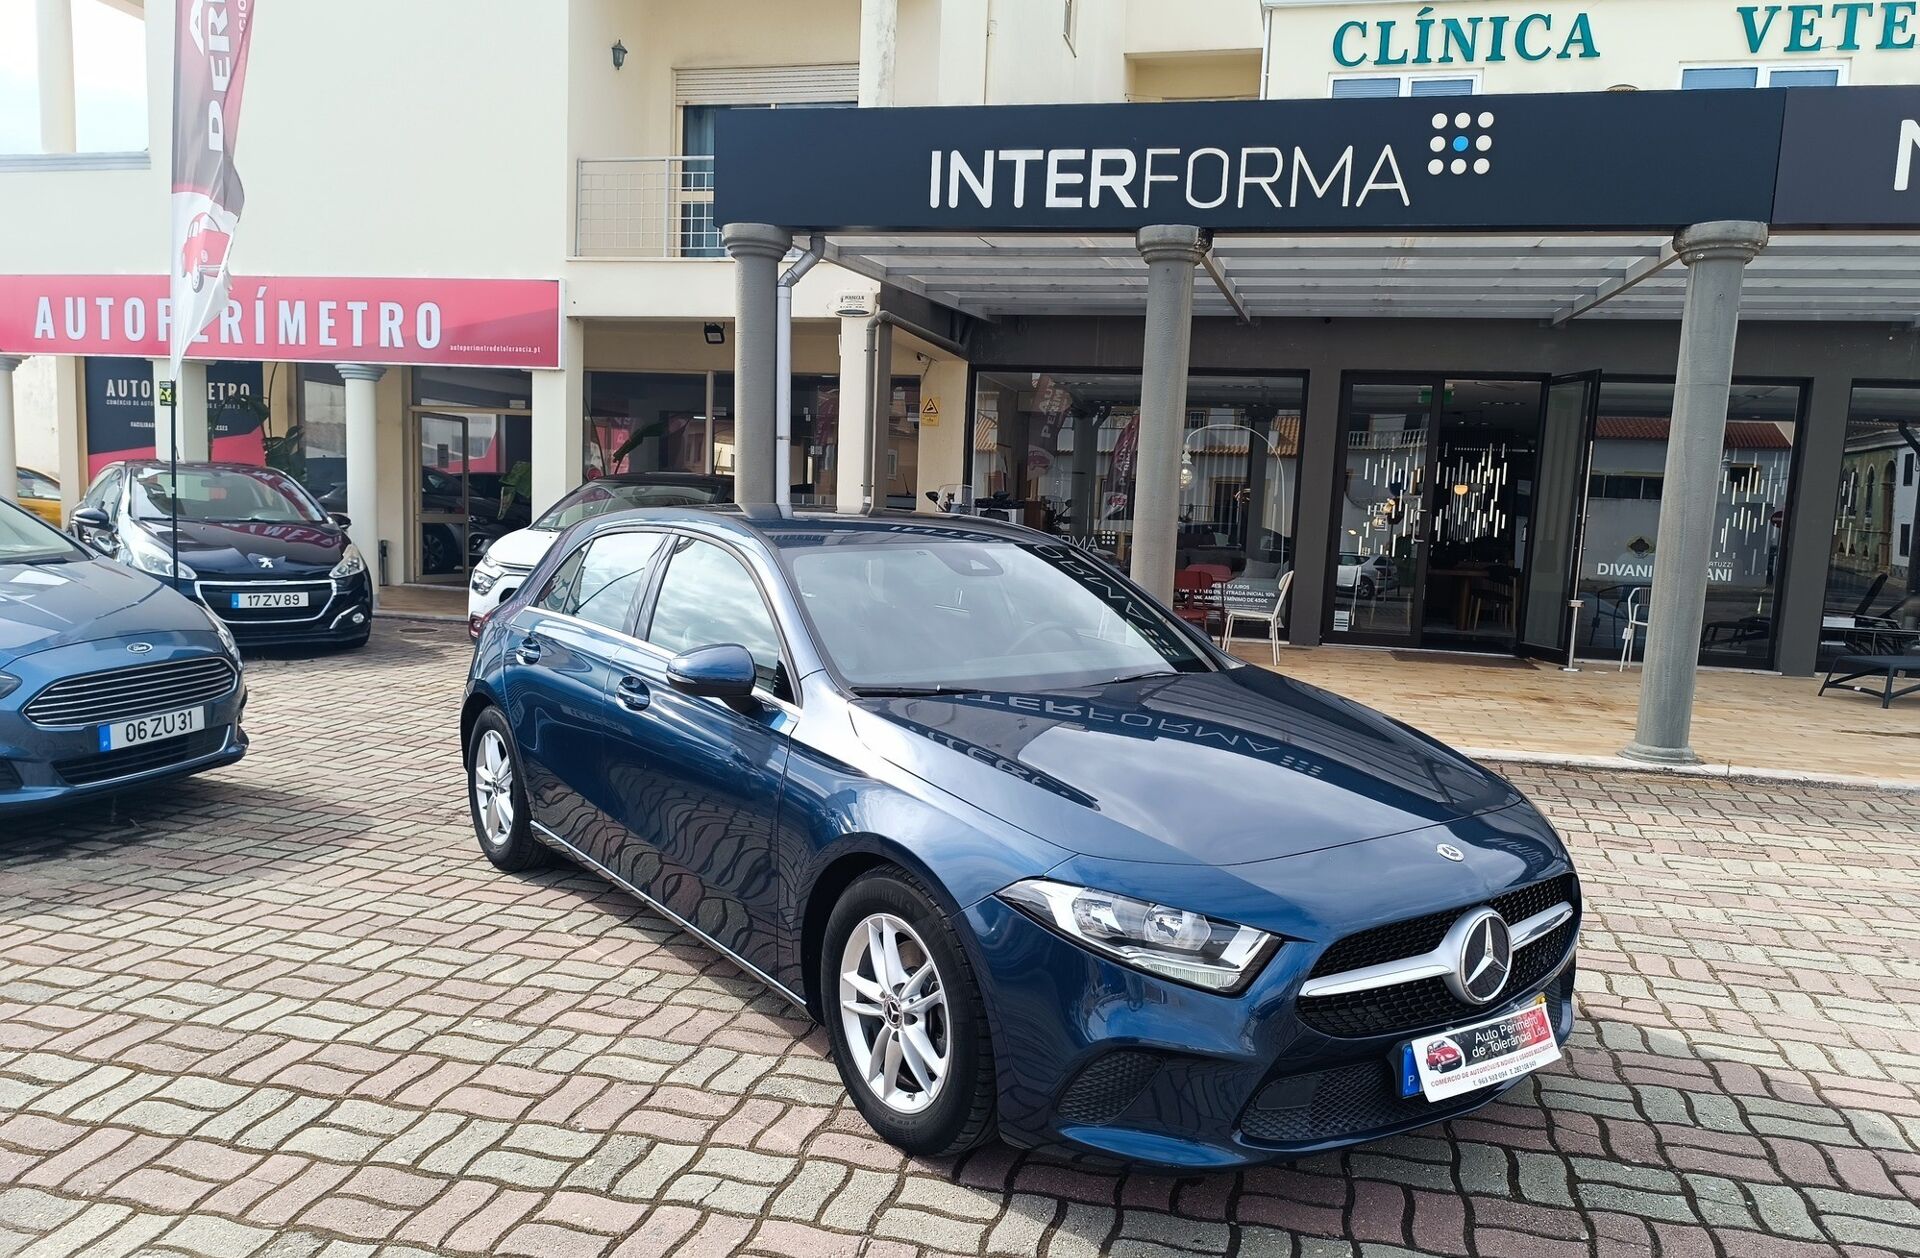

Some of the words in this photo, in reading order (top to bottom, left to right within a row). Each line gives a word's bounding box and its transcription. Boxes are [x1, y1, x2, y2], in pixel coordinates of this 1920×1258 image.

[1332, 6, 1600, 67] CLÍNICA
[1736, 1, 1917, 54] VETE
[929, 144, 1411, 209] INTERFORMA
[1597, 562, 1653, 578] DIVANI
[1475, 1027, 1499, 1044] Auto
[1472, 1044, 1486, 1058] de
